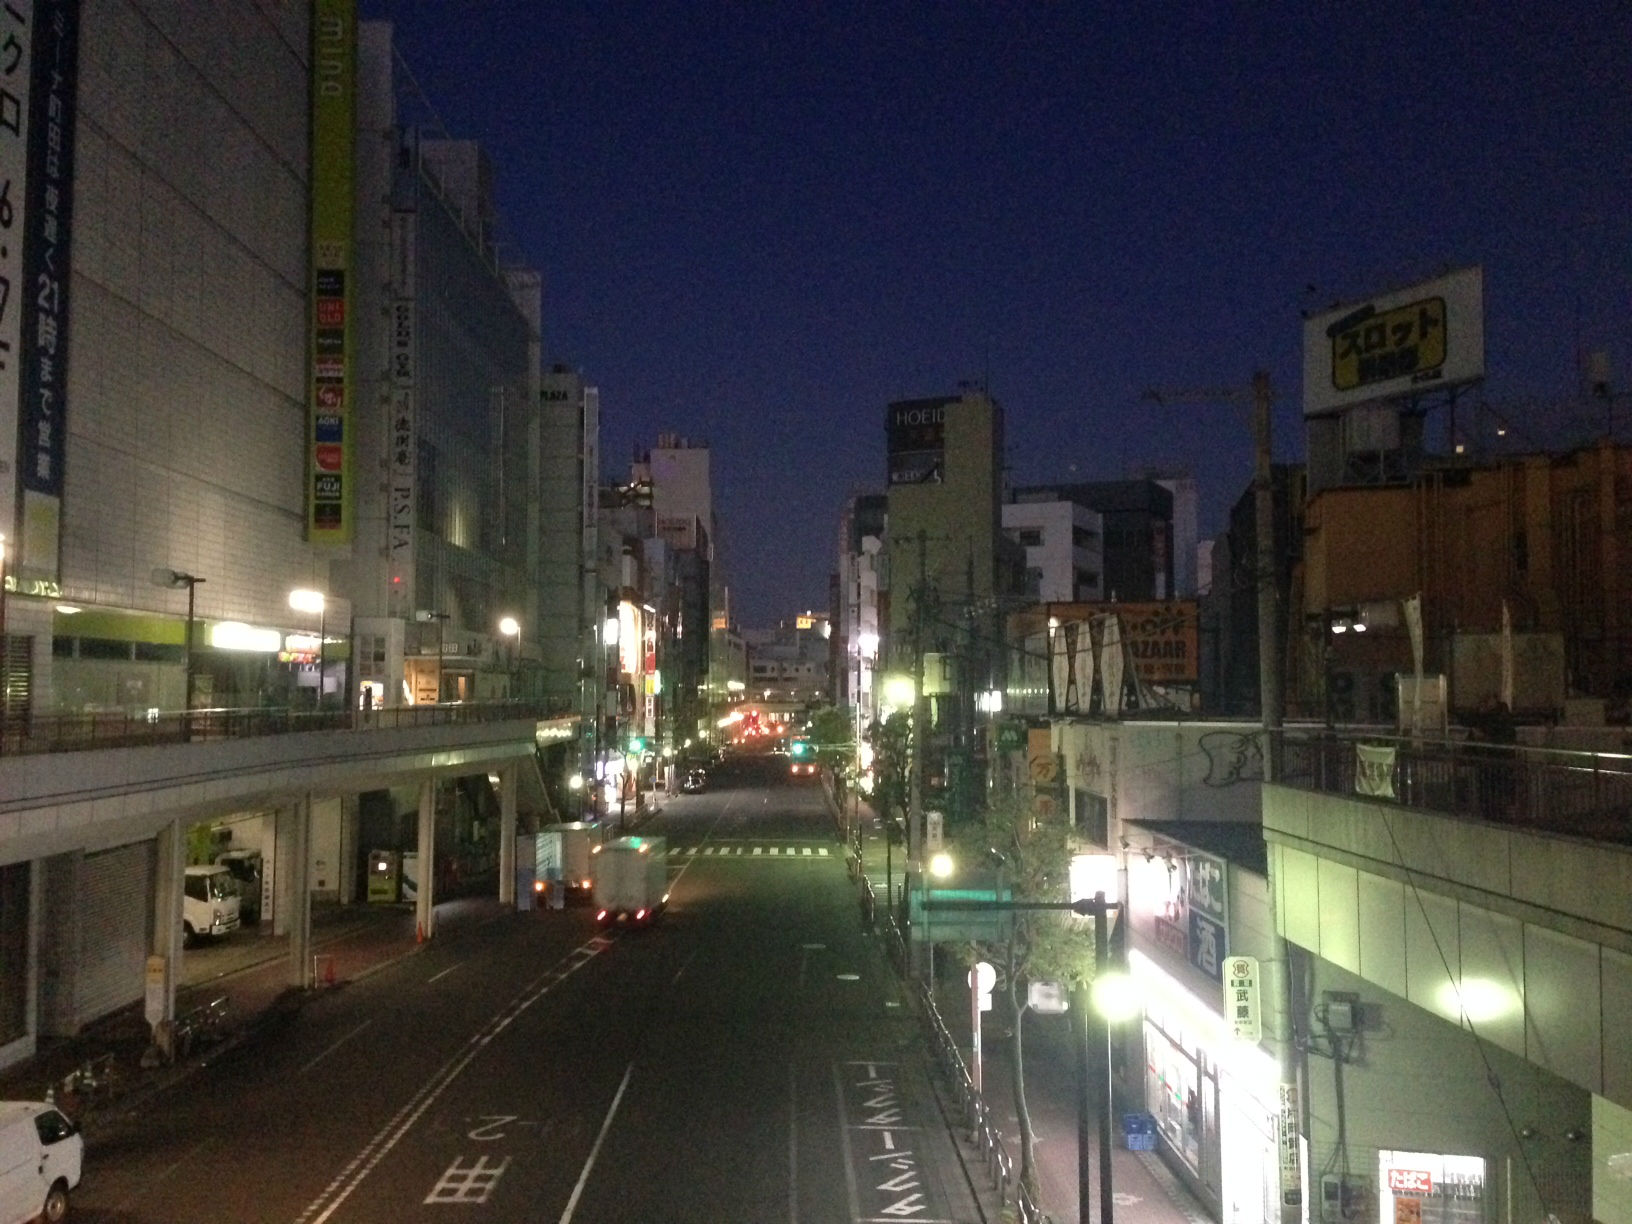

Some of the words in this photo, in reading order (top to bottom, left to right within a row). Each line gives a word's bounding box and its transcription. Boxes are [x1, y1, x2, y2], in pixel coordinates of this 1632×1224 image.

[1340, 307, 1438, 360] スロット
[318, 416, 339, 425] AOKI
[316, 481, 340, 490] FUJI
[1196, 916, 1217, 975] 酒
[869, 1131, 927, 1217] タクシー
[1390, 1170, 1429, 1190] たばこ
